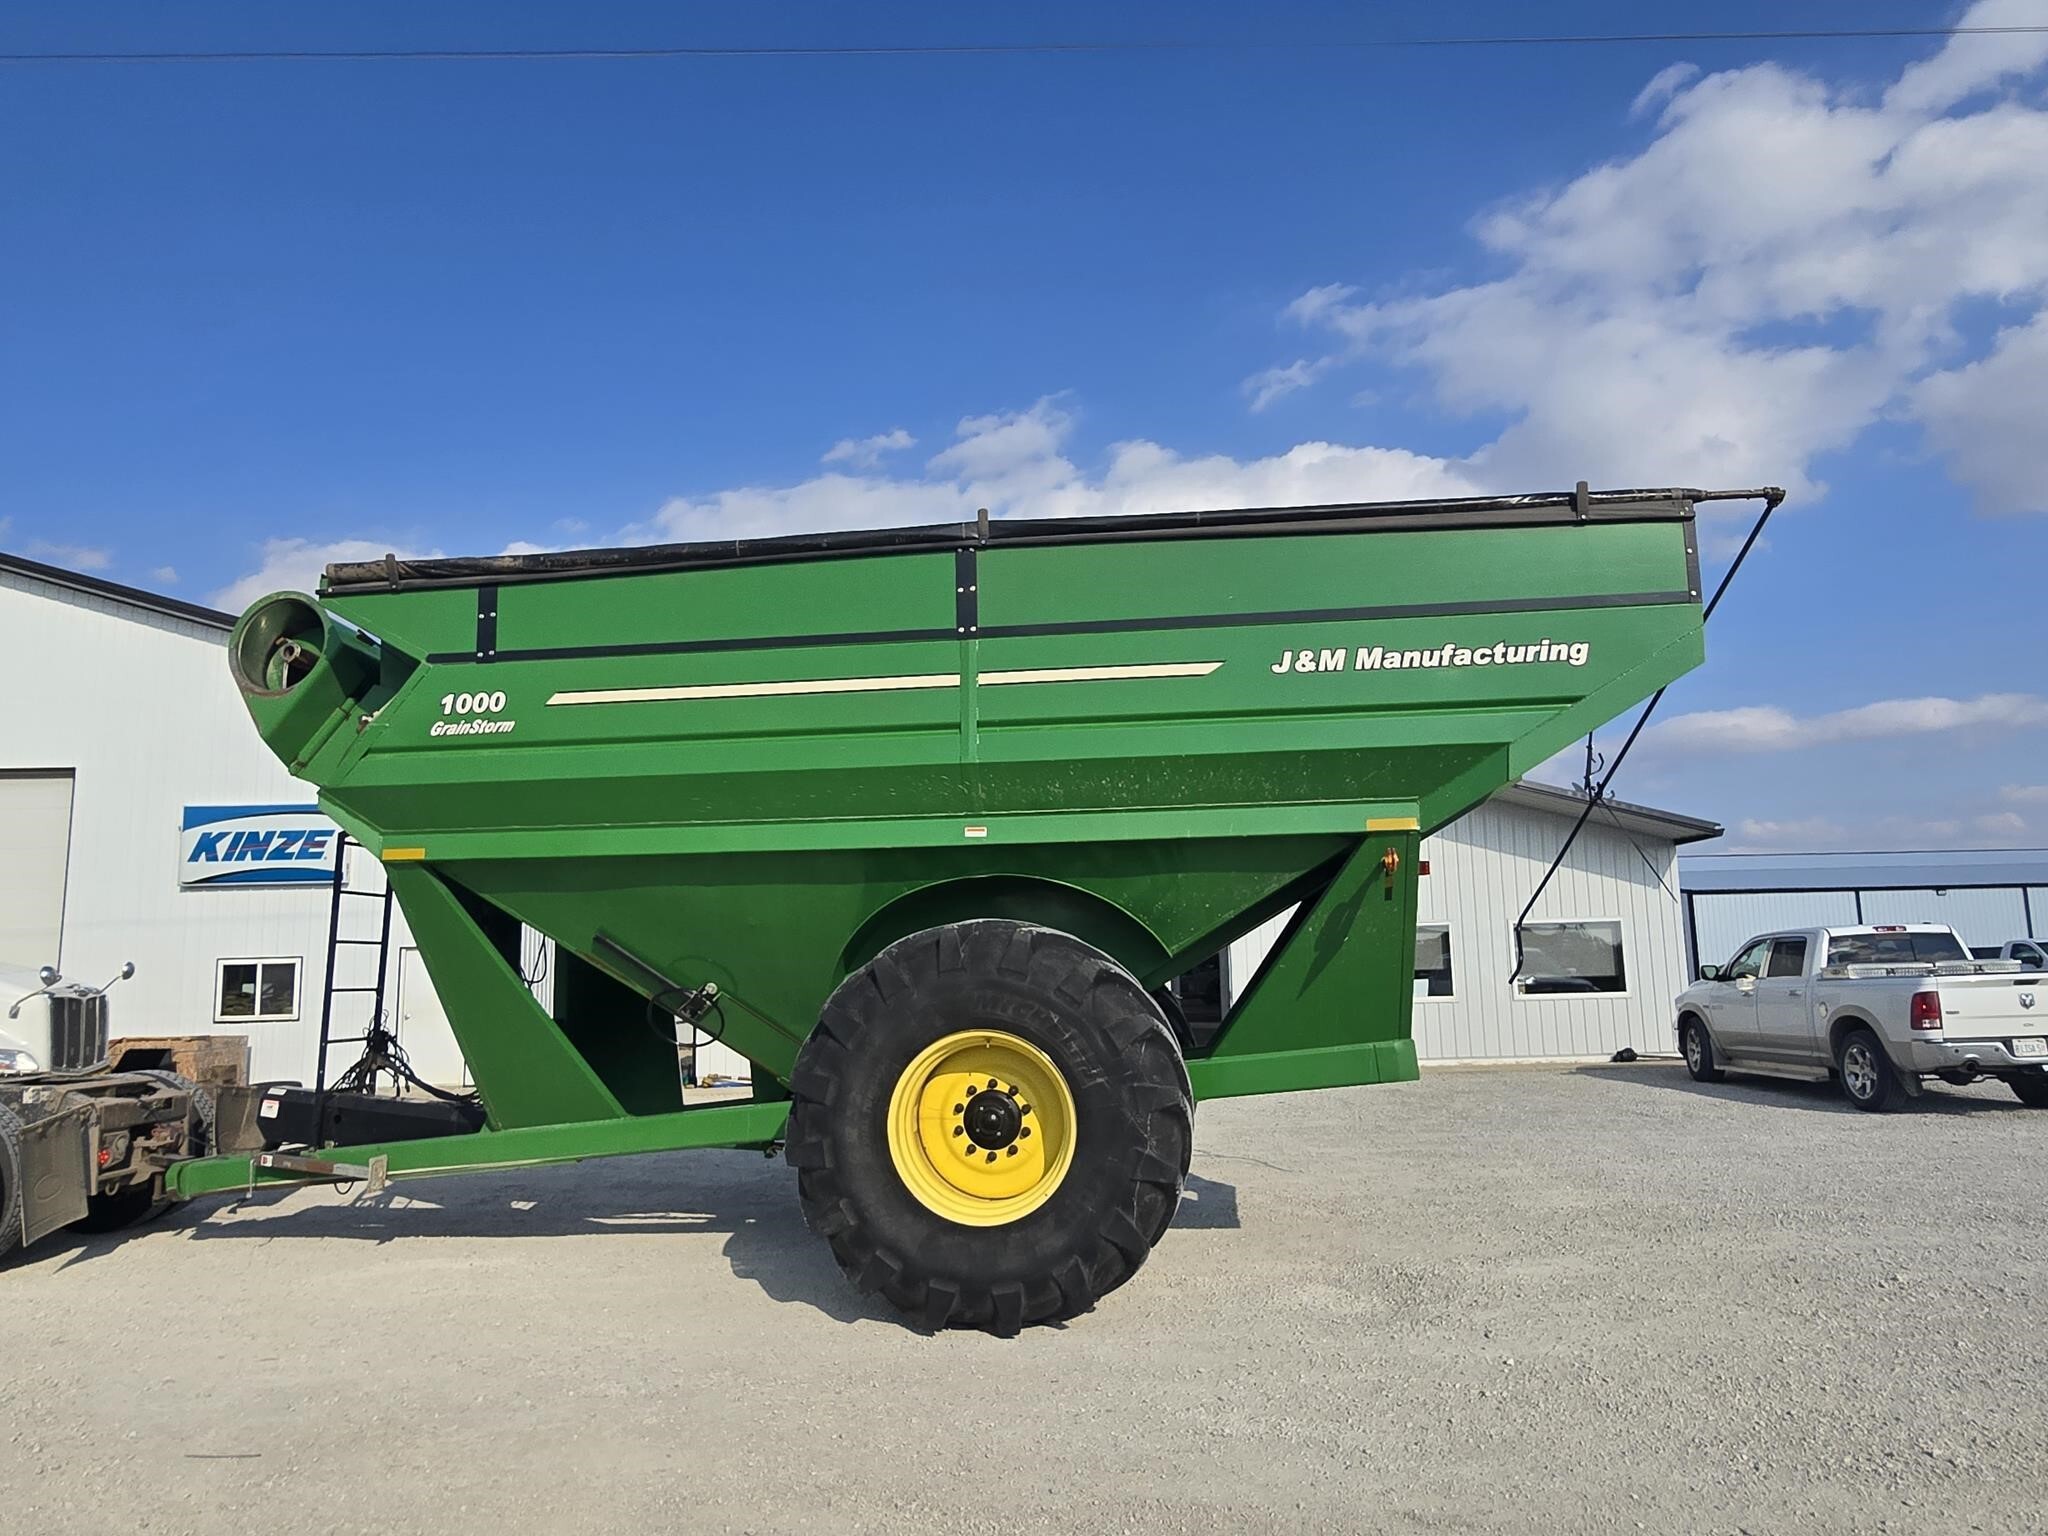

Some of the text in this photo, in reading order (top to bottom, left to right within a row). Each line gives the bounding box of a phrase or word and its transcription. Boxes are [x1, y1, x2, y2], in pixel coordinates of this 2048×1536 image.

[1271, 638, 1590, 674] J&M Manufacturing
[440, 690, 508, 716] 1000
[430, 718, 516, 737] GrainStorm
[187, 829, 335, 863] KINZE
